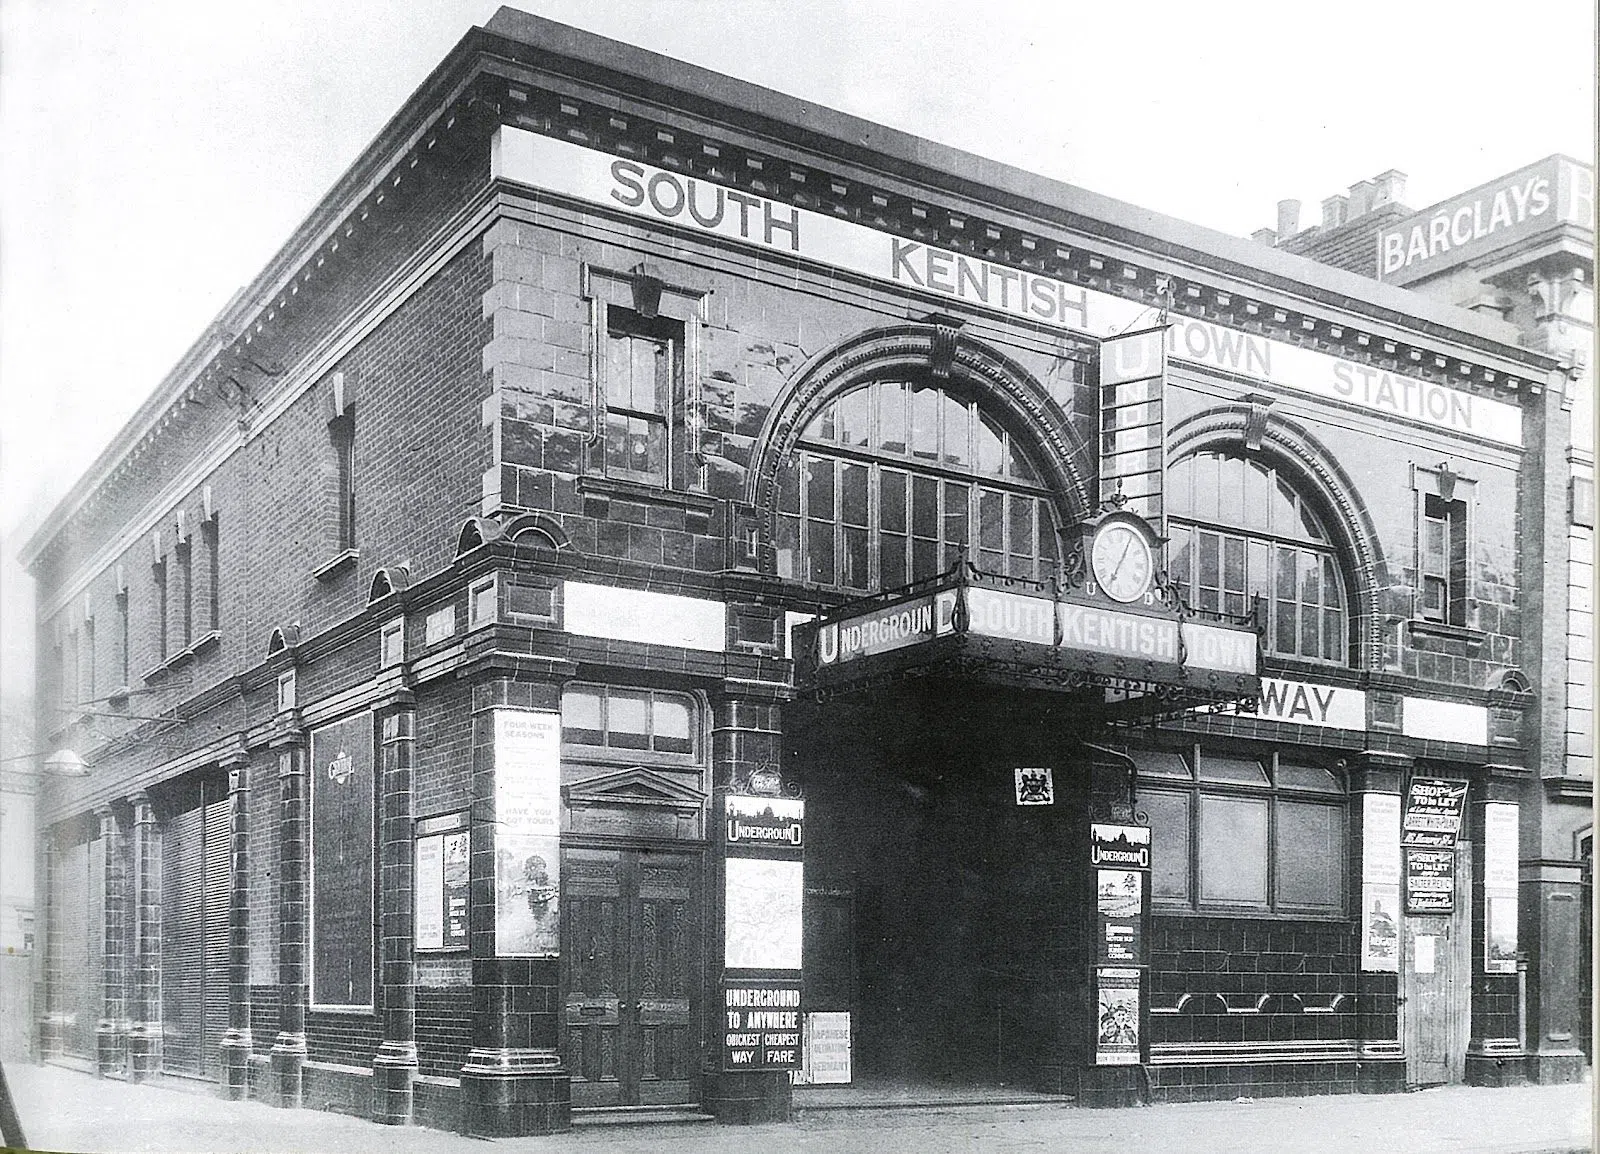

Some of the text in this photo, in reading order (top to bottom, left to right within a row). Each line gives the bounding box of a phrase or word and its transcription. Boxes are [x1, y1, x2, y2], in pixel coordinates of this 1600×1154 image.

[610, 160, 1473, 429] SOUTH KENTISH TOWN STATION
[1086, 582, 1154, 605] U D
[820, 594, 959, 664] UNDERGROUND
[970, 591, 1252, 669] SOUTH KENTISH TOWN
[1259, 681, 1336, 722] WAY
[1411, 785, 1446, 796] SHOP
[1413, 796, 1427, 805] TO
[1438, 798, 1458, 807] LET
[728, 820, 802, 845] UNDERGROUND
[1092, 845, 1149, 867] UNDERGROUND
[1410, 862, 1423, 870] TO
[726, 989, 801, 1007] UNDERGROUND
[727, 1012, 741, 1029] TO
[747, 1012, 798, 1028] ANYWHERE
[726, 1033, 760, 1046] QUICKEST
[764, 1033, 800, 1046] CHEAPEST
[731, 1050, 755, 1063] WAY
[767, 1050, 796, 1063] FARE
